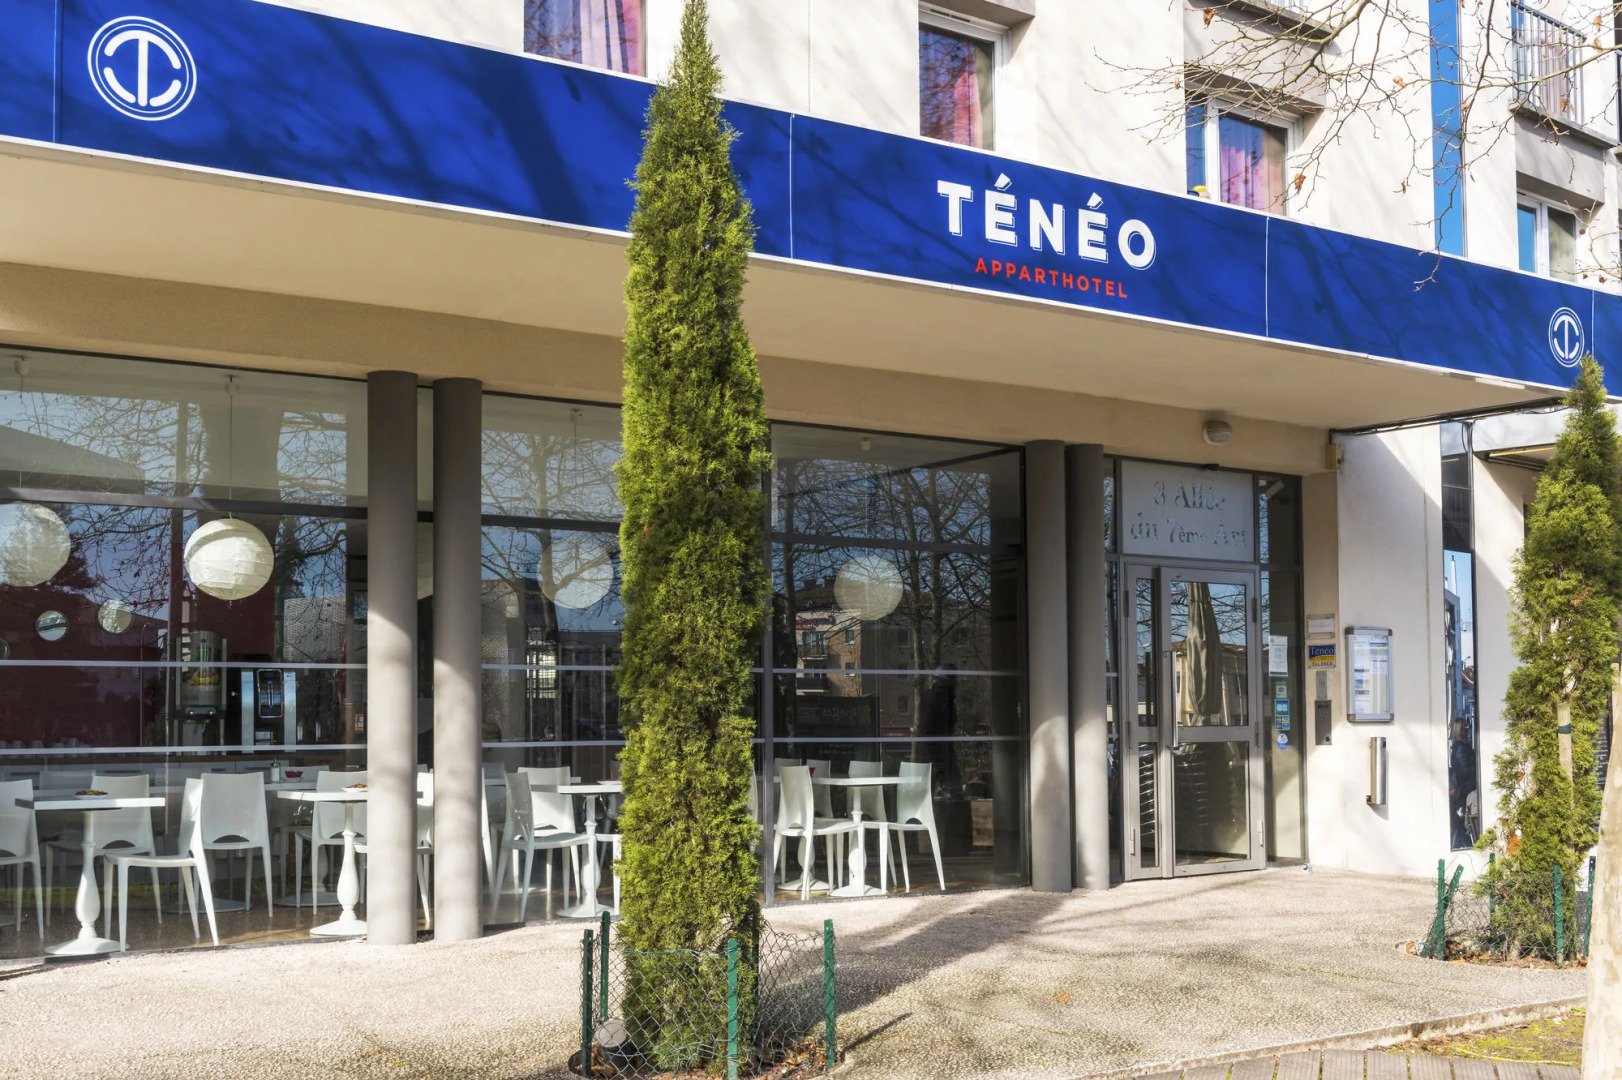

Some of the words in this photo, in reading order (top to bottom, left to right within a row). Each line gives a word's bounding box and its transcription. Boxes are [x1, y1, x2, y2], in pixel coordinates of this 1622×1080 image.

[937, 172, 1157, 271] TÉNÉO
[975, 257, 1128, 299] APPARTHOTEL
[1311, 646, 1334, 656] Ténéo
